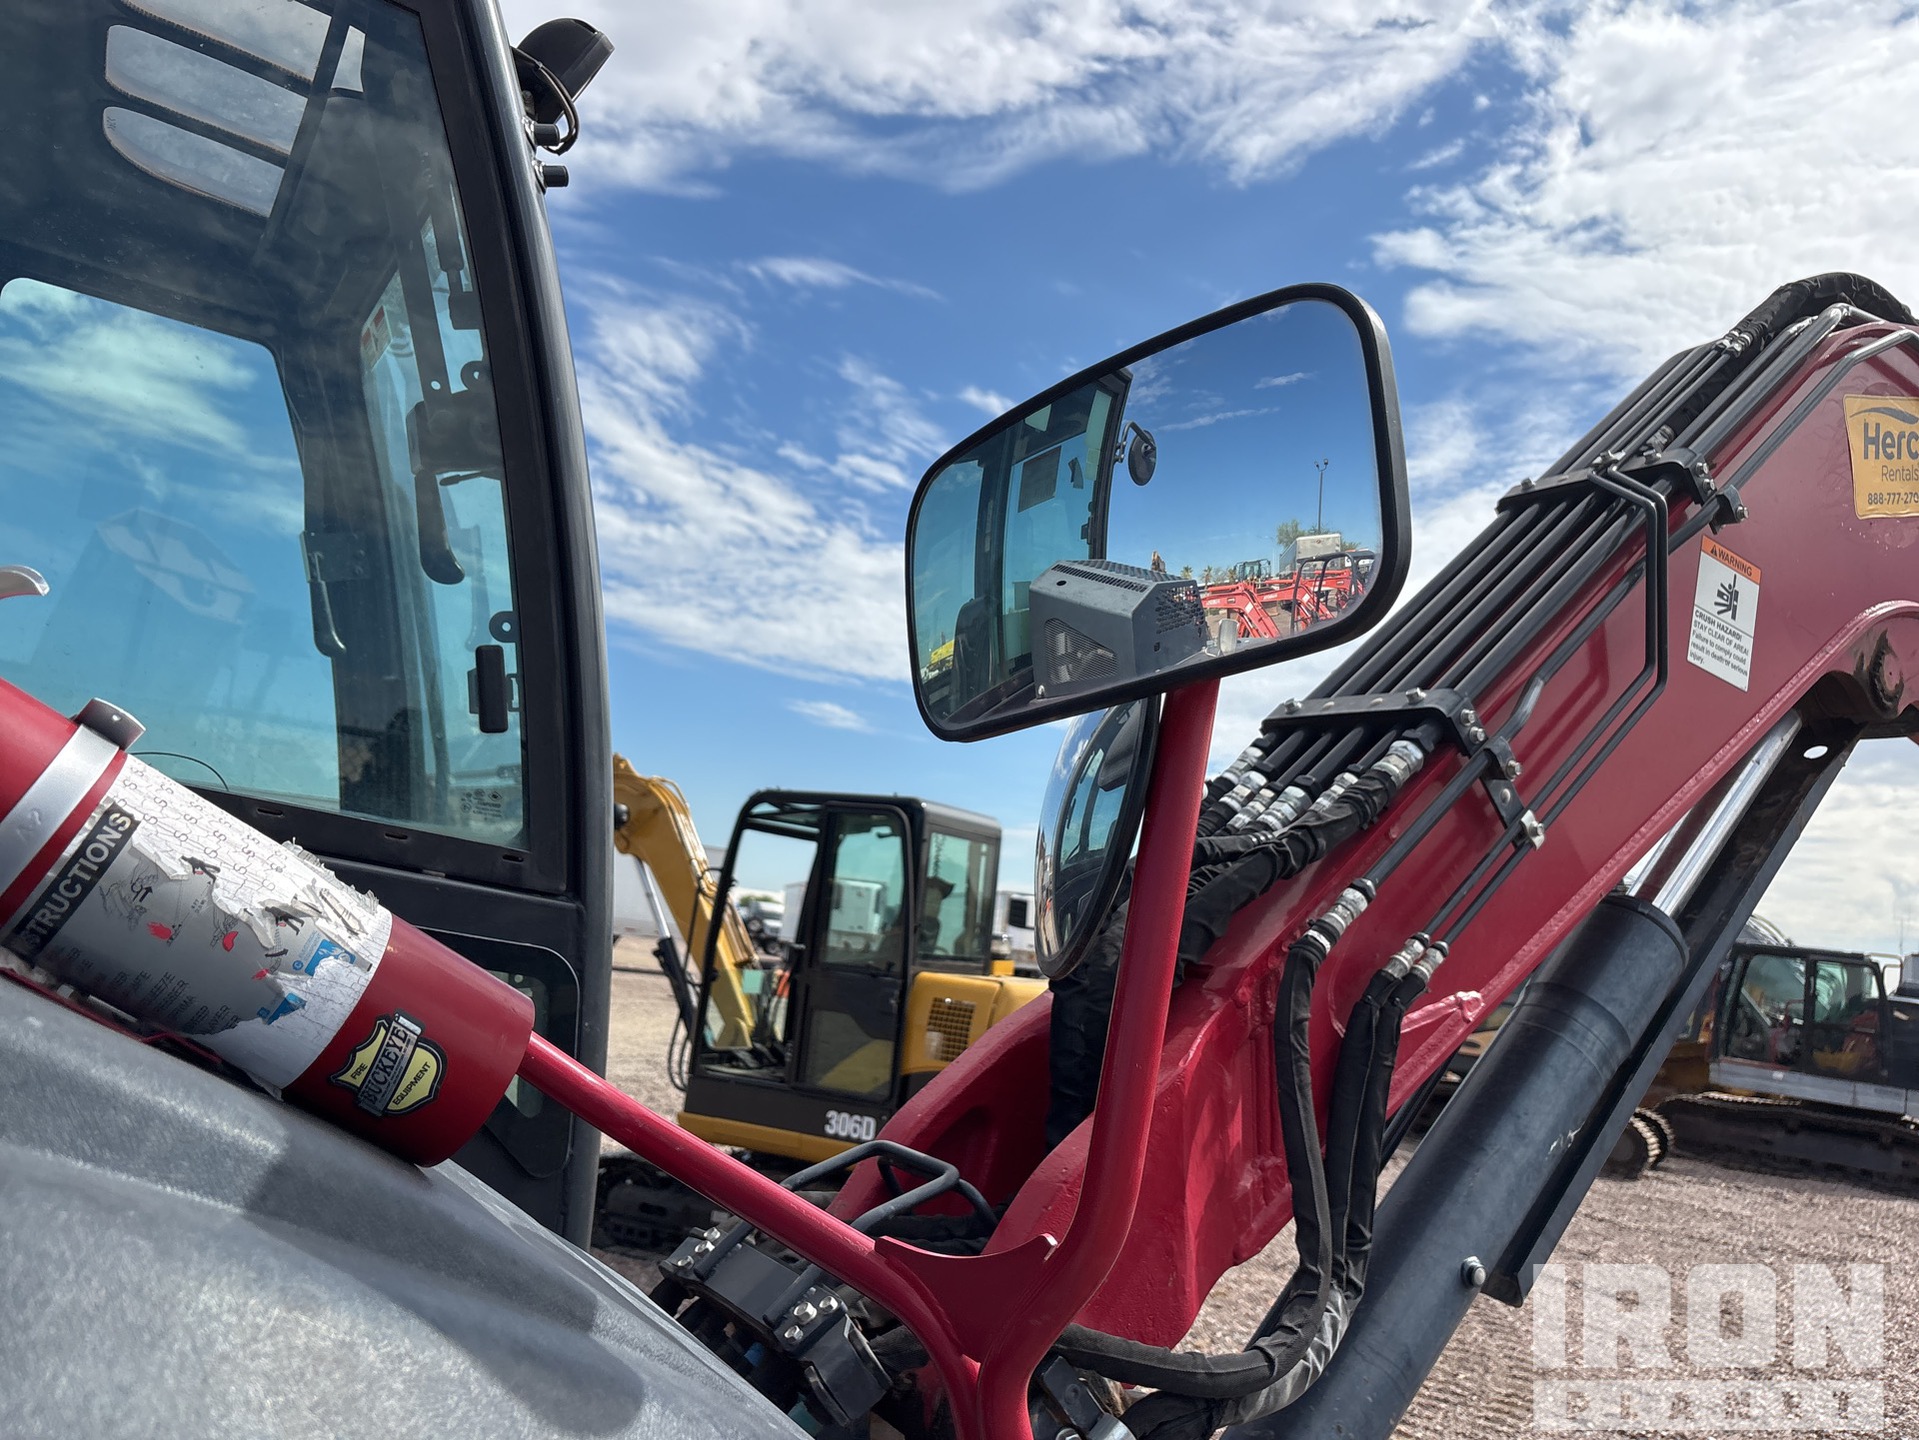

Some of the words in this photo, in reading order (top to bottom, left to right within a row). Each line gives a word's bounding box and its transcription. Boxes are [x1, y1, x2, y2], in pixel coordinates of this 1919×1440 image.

[1863, 421, 1919, 461] Herc
[1881, 464, 1919, 483] Rentals
[1718, 548, 1753, 578] WARNING
[1693, 619, 1708, 633] STAY
[1707, 627, 1725, 644] CLEAR
[1725, 637, 1733, 647] OF
[1694, 609, 1716, 627] CRUSH
[1691, 641, 1705, 654] result
[1730, 663, 1748, 677] serious
[1692, 629, 1709, 645] Failure
[1709, 639, 1715, 648] to
[1714, 643, 1733, 660] comply
[1732, 653, 1747, 666] could
[350, 1062, 369, 1080] FIRE
[361, 1025, 409, 1105] BUCKEYE
[392, 1061, 431, 1106] EQUIPMENT
[823, 1109, 877, 1141] 306D
